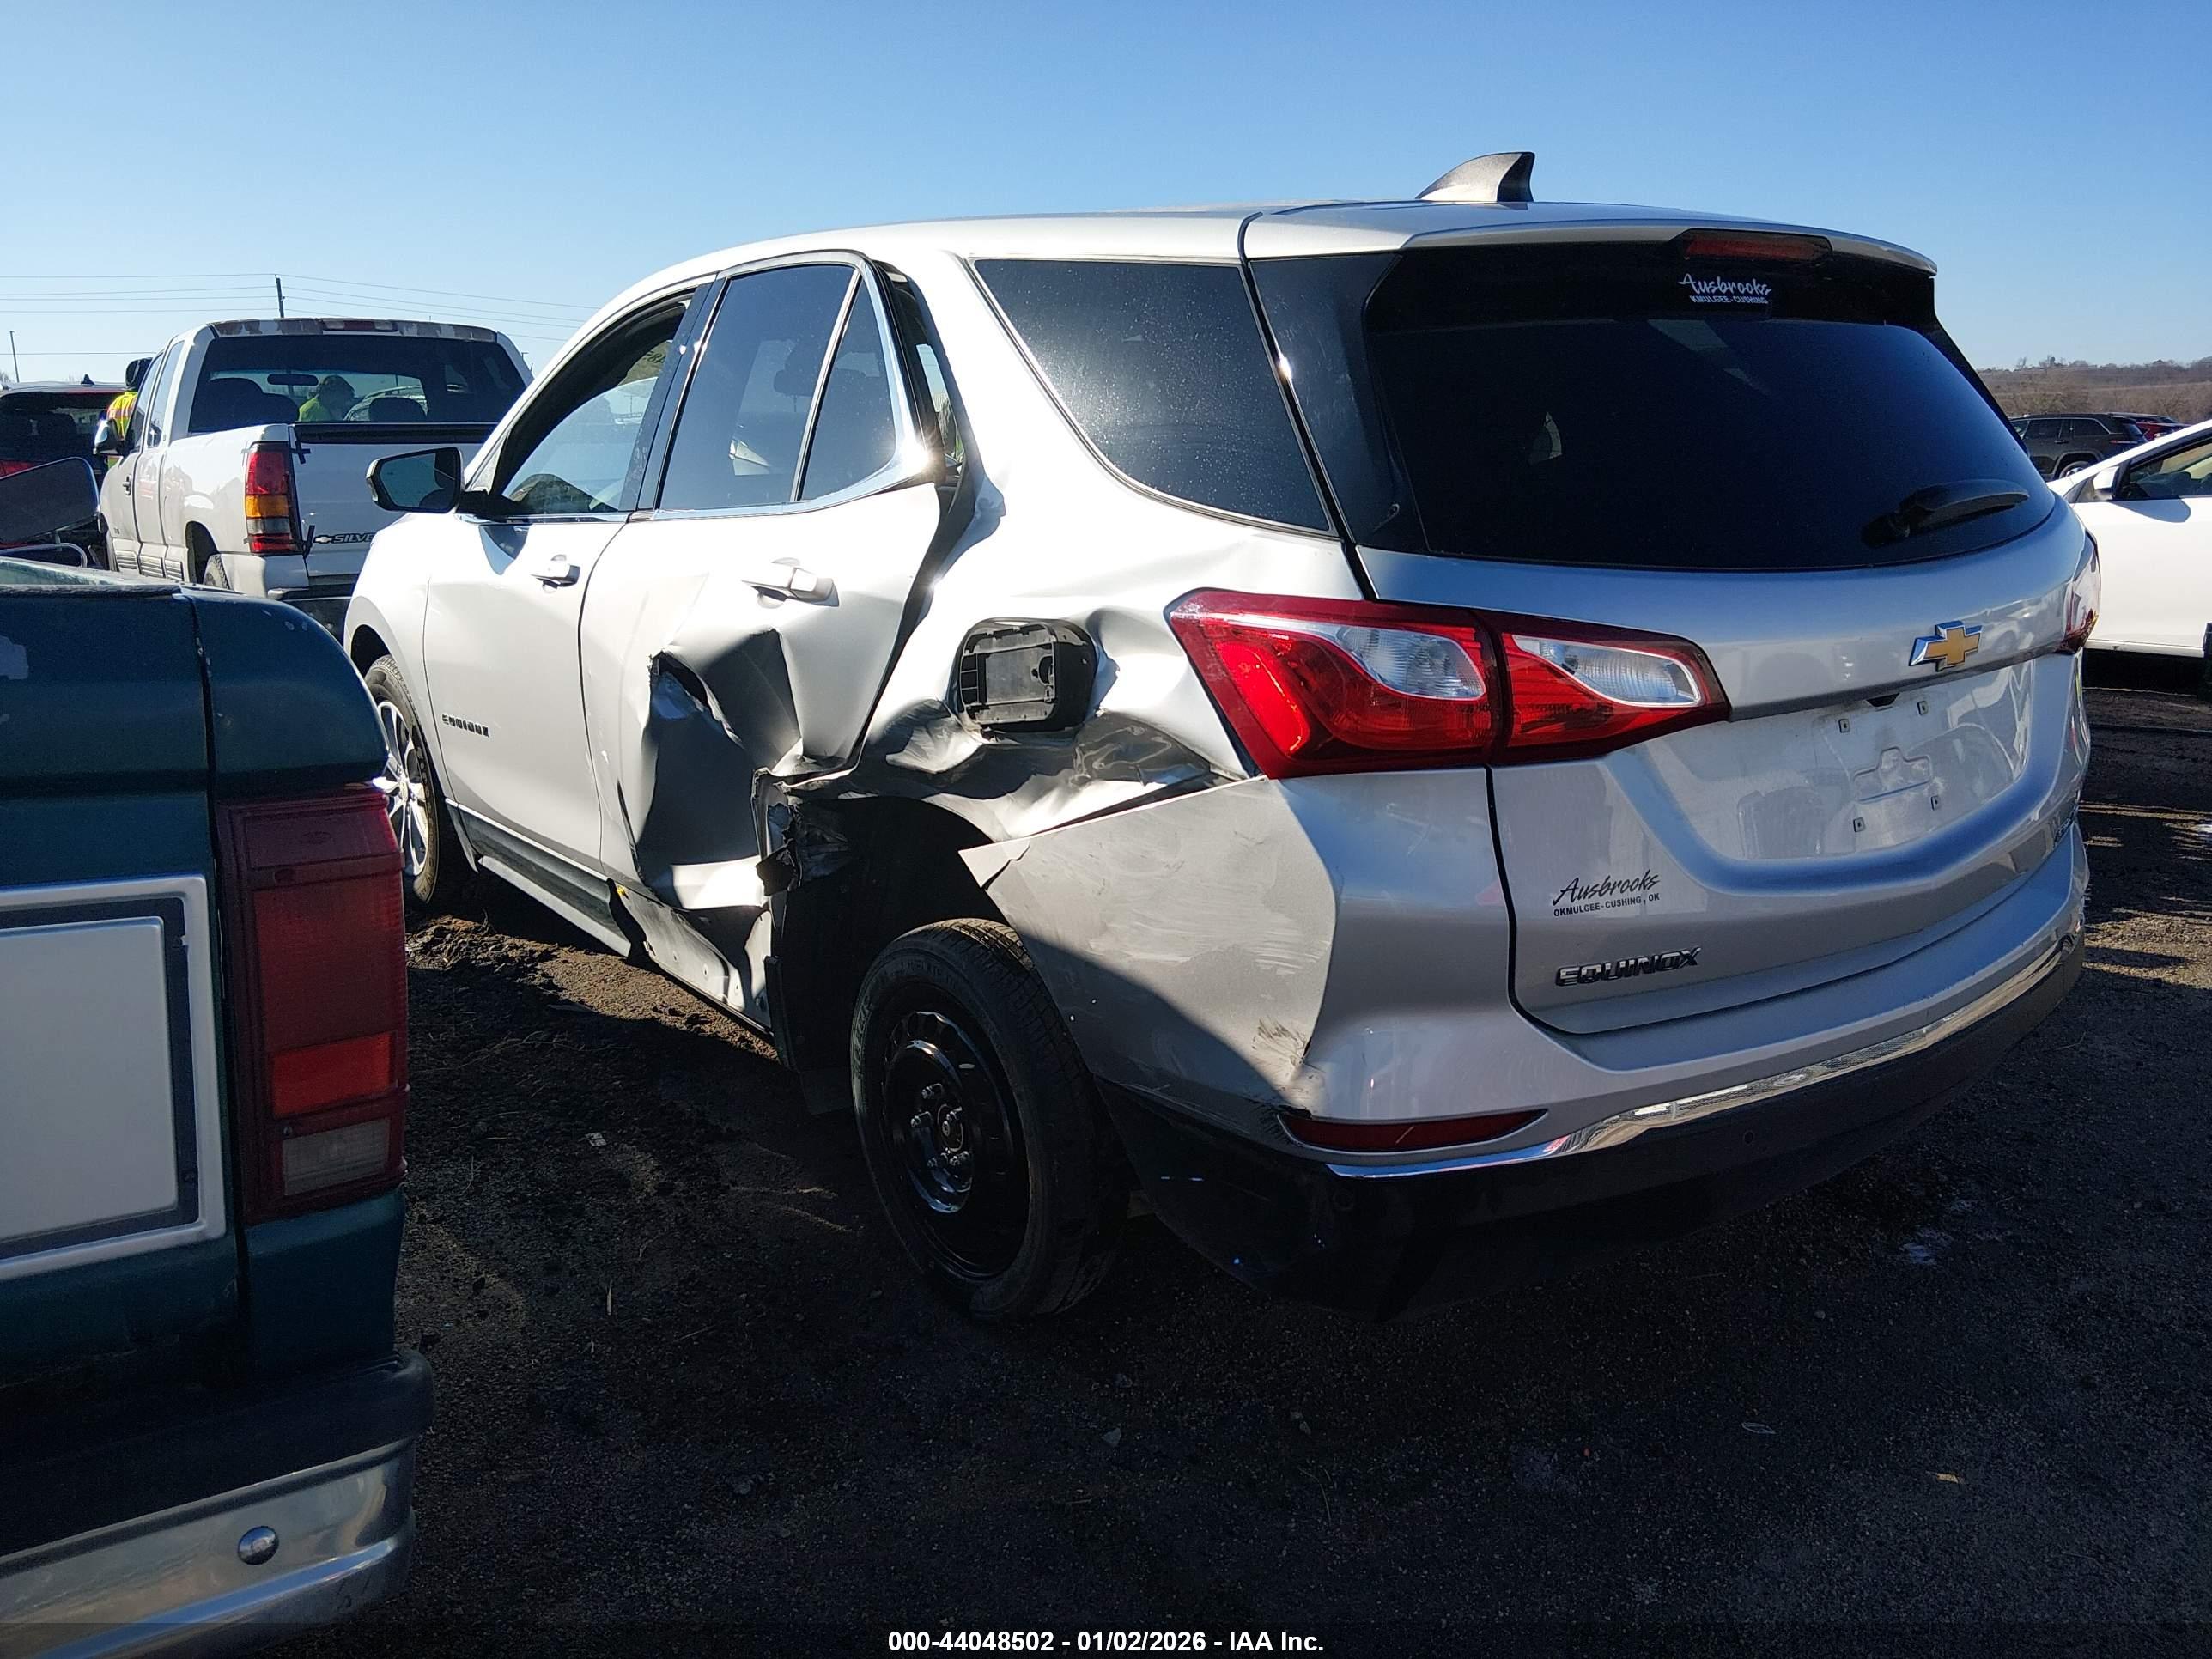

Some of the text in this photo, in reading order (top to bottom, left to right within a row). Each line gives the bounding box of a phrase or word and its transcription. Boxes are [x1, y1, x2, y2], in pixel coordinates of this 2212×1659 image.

[1678, 273, 1772, 295] Ausbrooks
[1553, 870, 1661, 905] Ausbrooks
[1648, 892, 1660, 902] OK
[1555, 946, 1701, 986] EQUINOX
